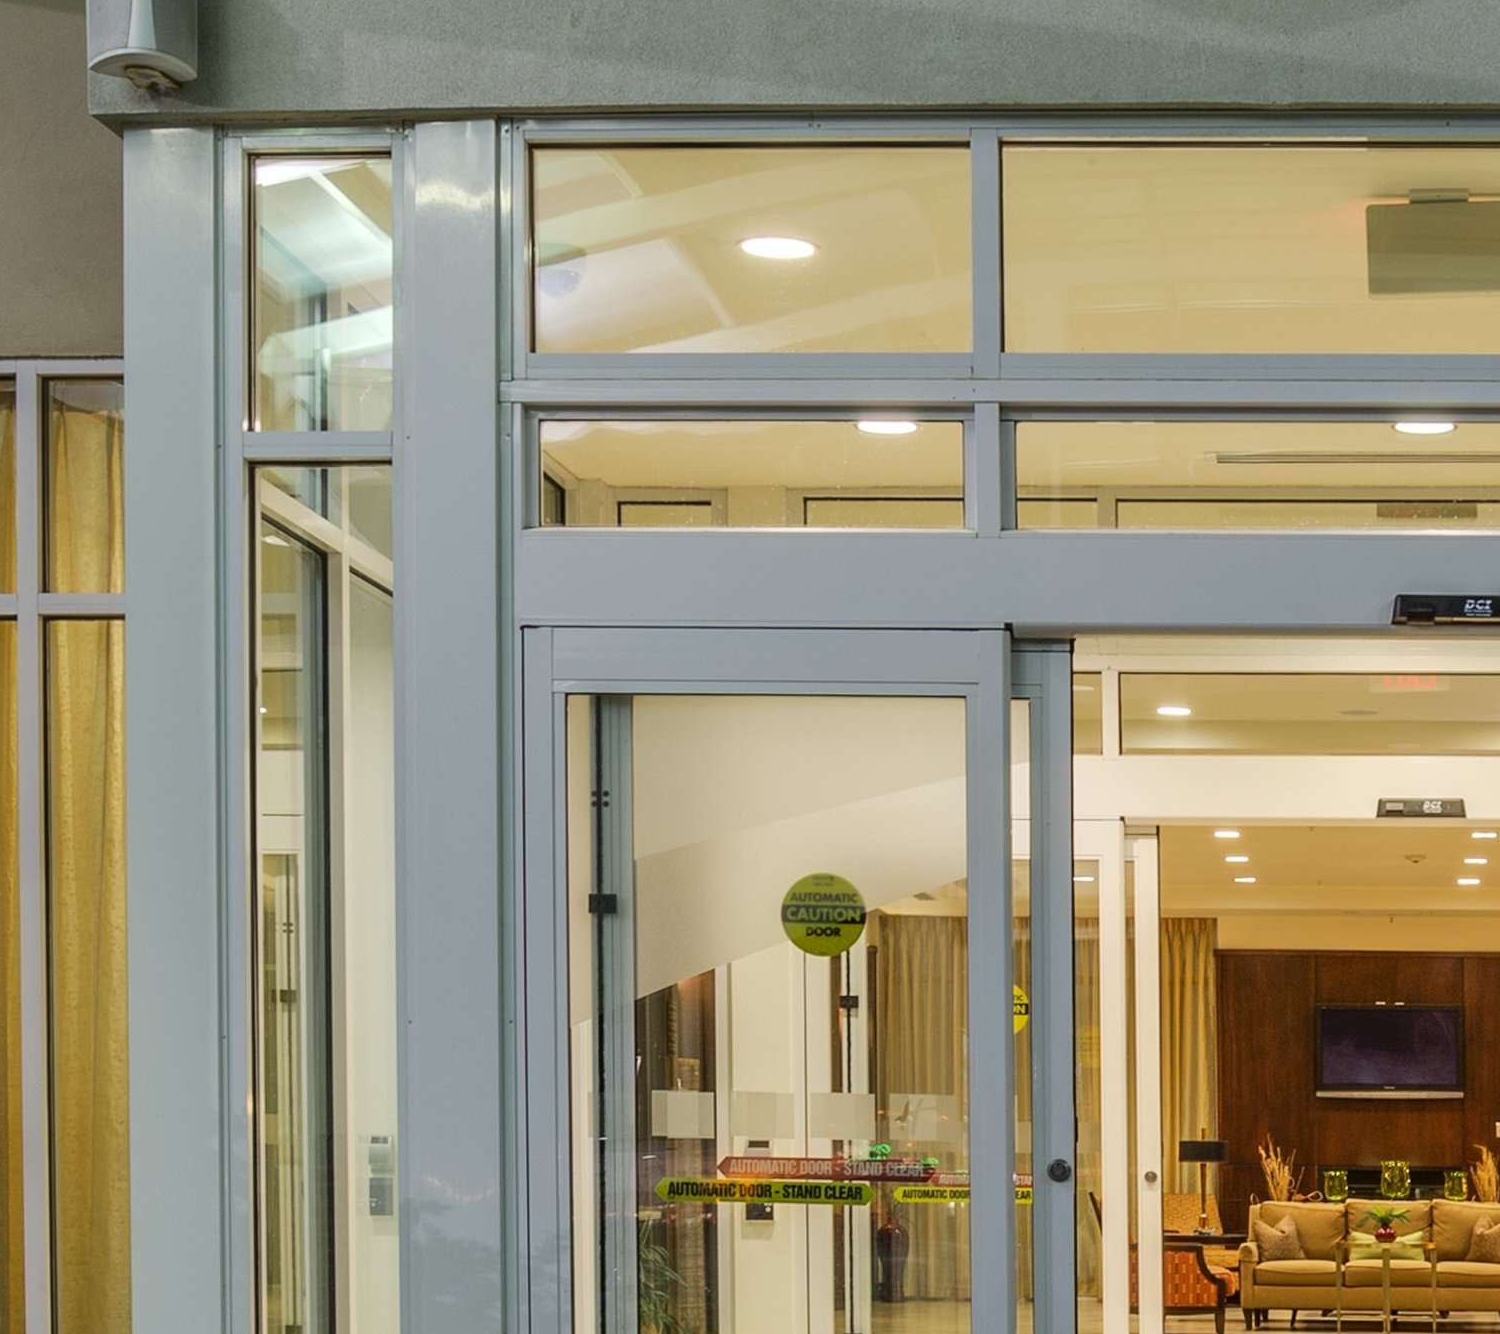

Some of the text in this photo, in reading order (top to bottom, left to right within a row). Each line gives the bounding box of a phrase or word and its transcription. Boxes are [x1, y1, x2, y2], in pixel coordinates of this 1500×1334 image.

[790, 893, 858, 903] AUTOMATIC
[786, 907, 861, 922] CAUTION
[806, 927, 841, 936] DOOR
[729, 1158, 797, 1175] AUTOMATIC
[800, 1160, 833, 1175] DOOR
[843, 1161, 883, 1176] STAND
[668, 1181, 736, 1197] AUTOMATIC
[739, 1183, 772, 1198] DOOR
[782, 1185, 821, 1199] STAND
[824, 1186, 863, 1200] CLEAR
[902, 1189, 947, 1199] AUTOMATIC
